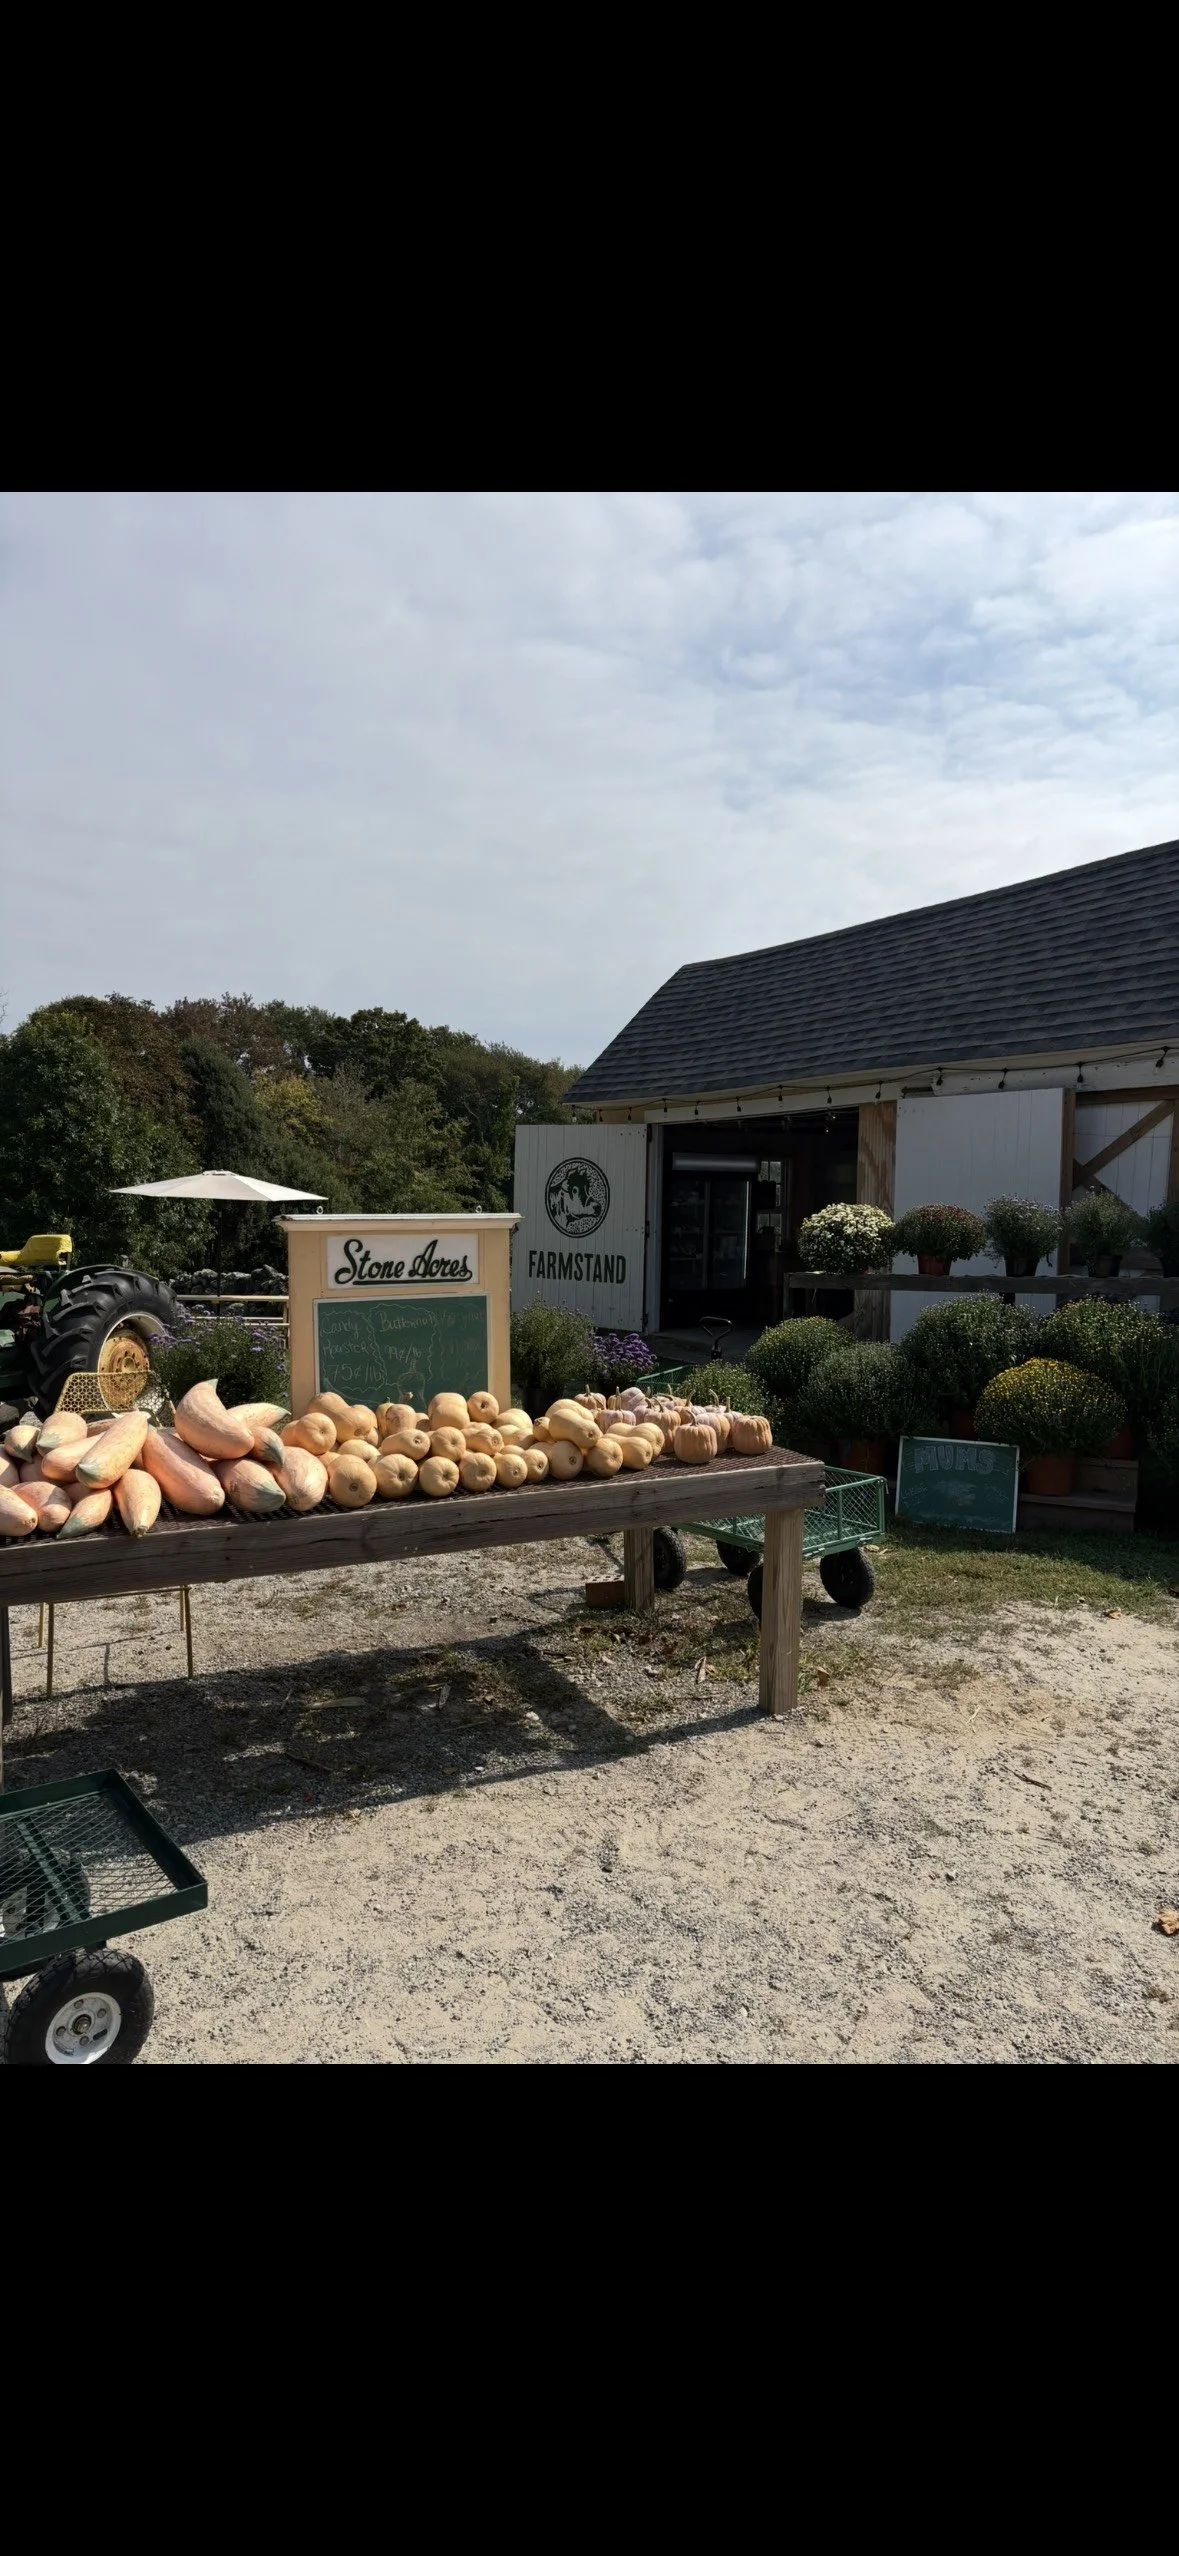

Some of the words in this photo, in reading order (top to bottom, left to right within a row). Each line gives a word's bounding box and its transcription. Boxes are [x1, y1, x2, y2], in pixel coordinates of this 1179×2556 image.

[334, 1238, 405, 1284] Stone
[408, 1239, 473, 1281] Acres
[529, 1250, 626, 1284] FARMSTAND
[914, 1445, 994, 1475] MUMS
